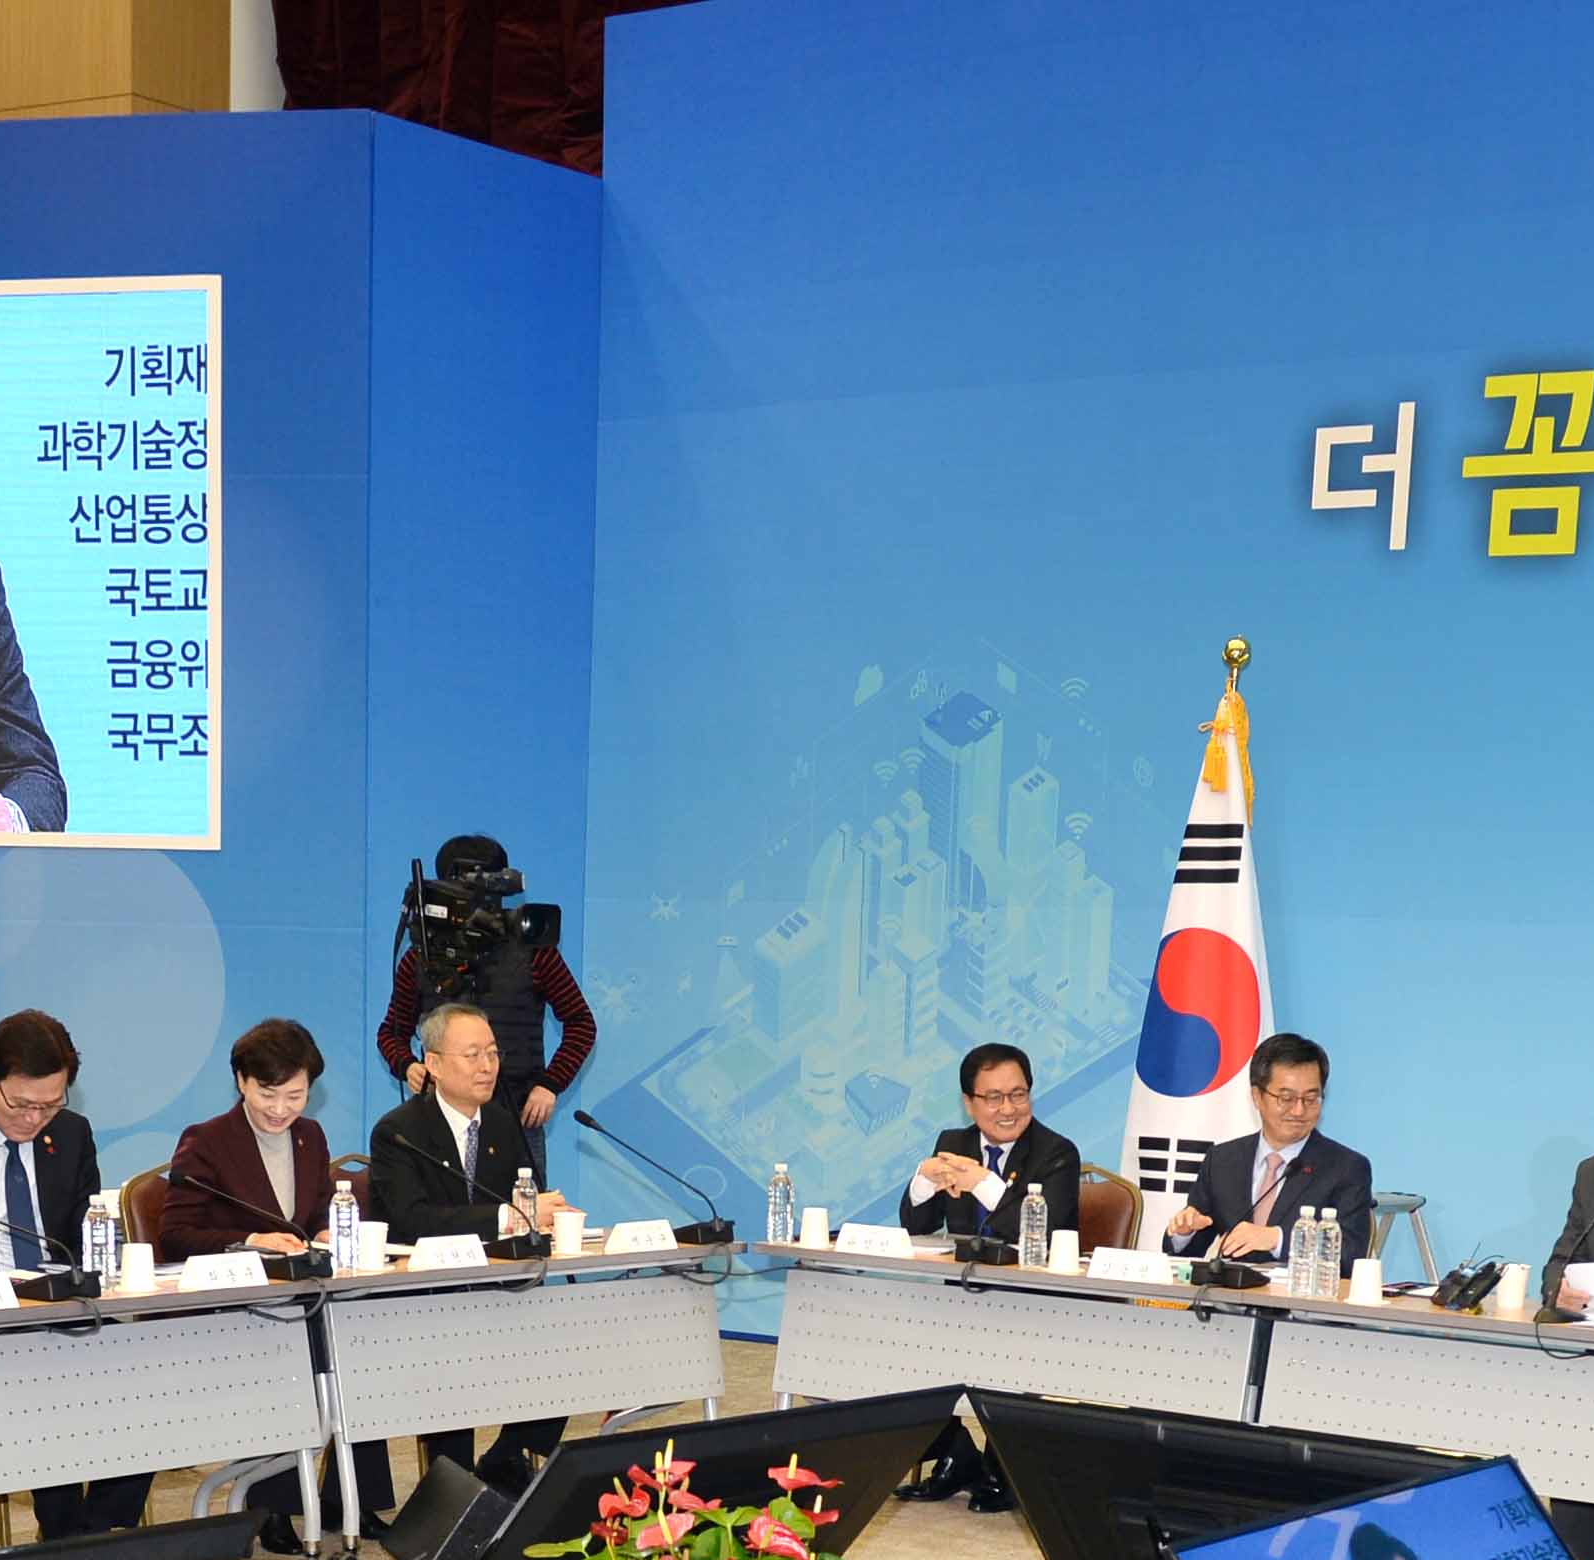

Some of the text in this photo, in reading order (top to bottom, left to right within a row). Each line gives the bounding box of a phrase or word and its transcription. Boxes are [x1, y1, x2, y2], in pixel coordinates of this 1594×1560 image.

[37, 417, 208, 471] 과학기술정
[1311, 402, 1415, 550] 더
[69, 492, 208, 544] 산업통상
[106, 568, 208, 617] 국토교
[107, 639, 209, 690] 금융위
[108, 713, 208, 761] 국무조
